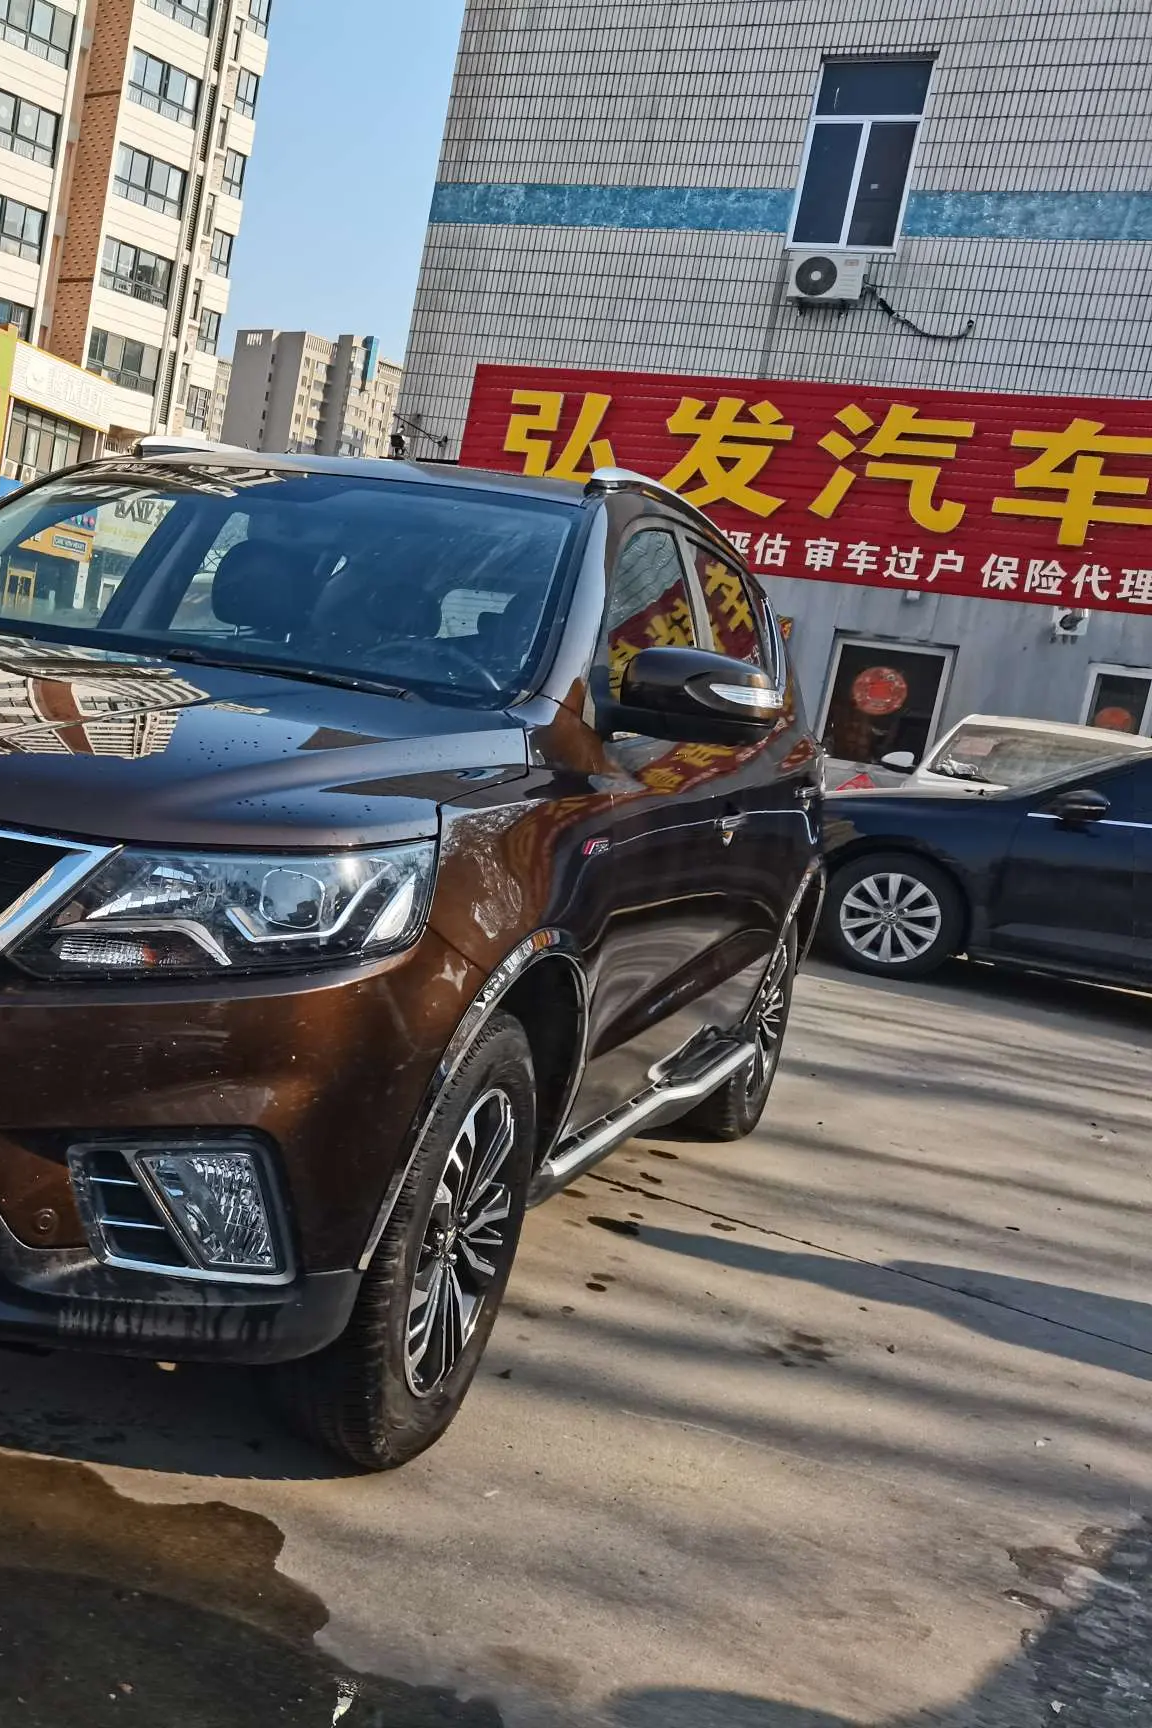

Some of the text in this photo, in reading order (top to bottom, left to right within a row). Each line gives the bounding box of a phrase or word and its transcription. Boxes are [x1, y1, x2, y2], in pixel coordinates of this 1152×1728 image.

[503, 389, 1152, 546] 弘发汽车
[804, 538, 965, 583] 审车过户
[980, 553, 1152, 605] 保险代理
